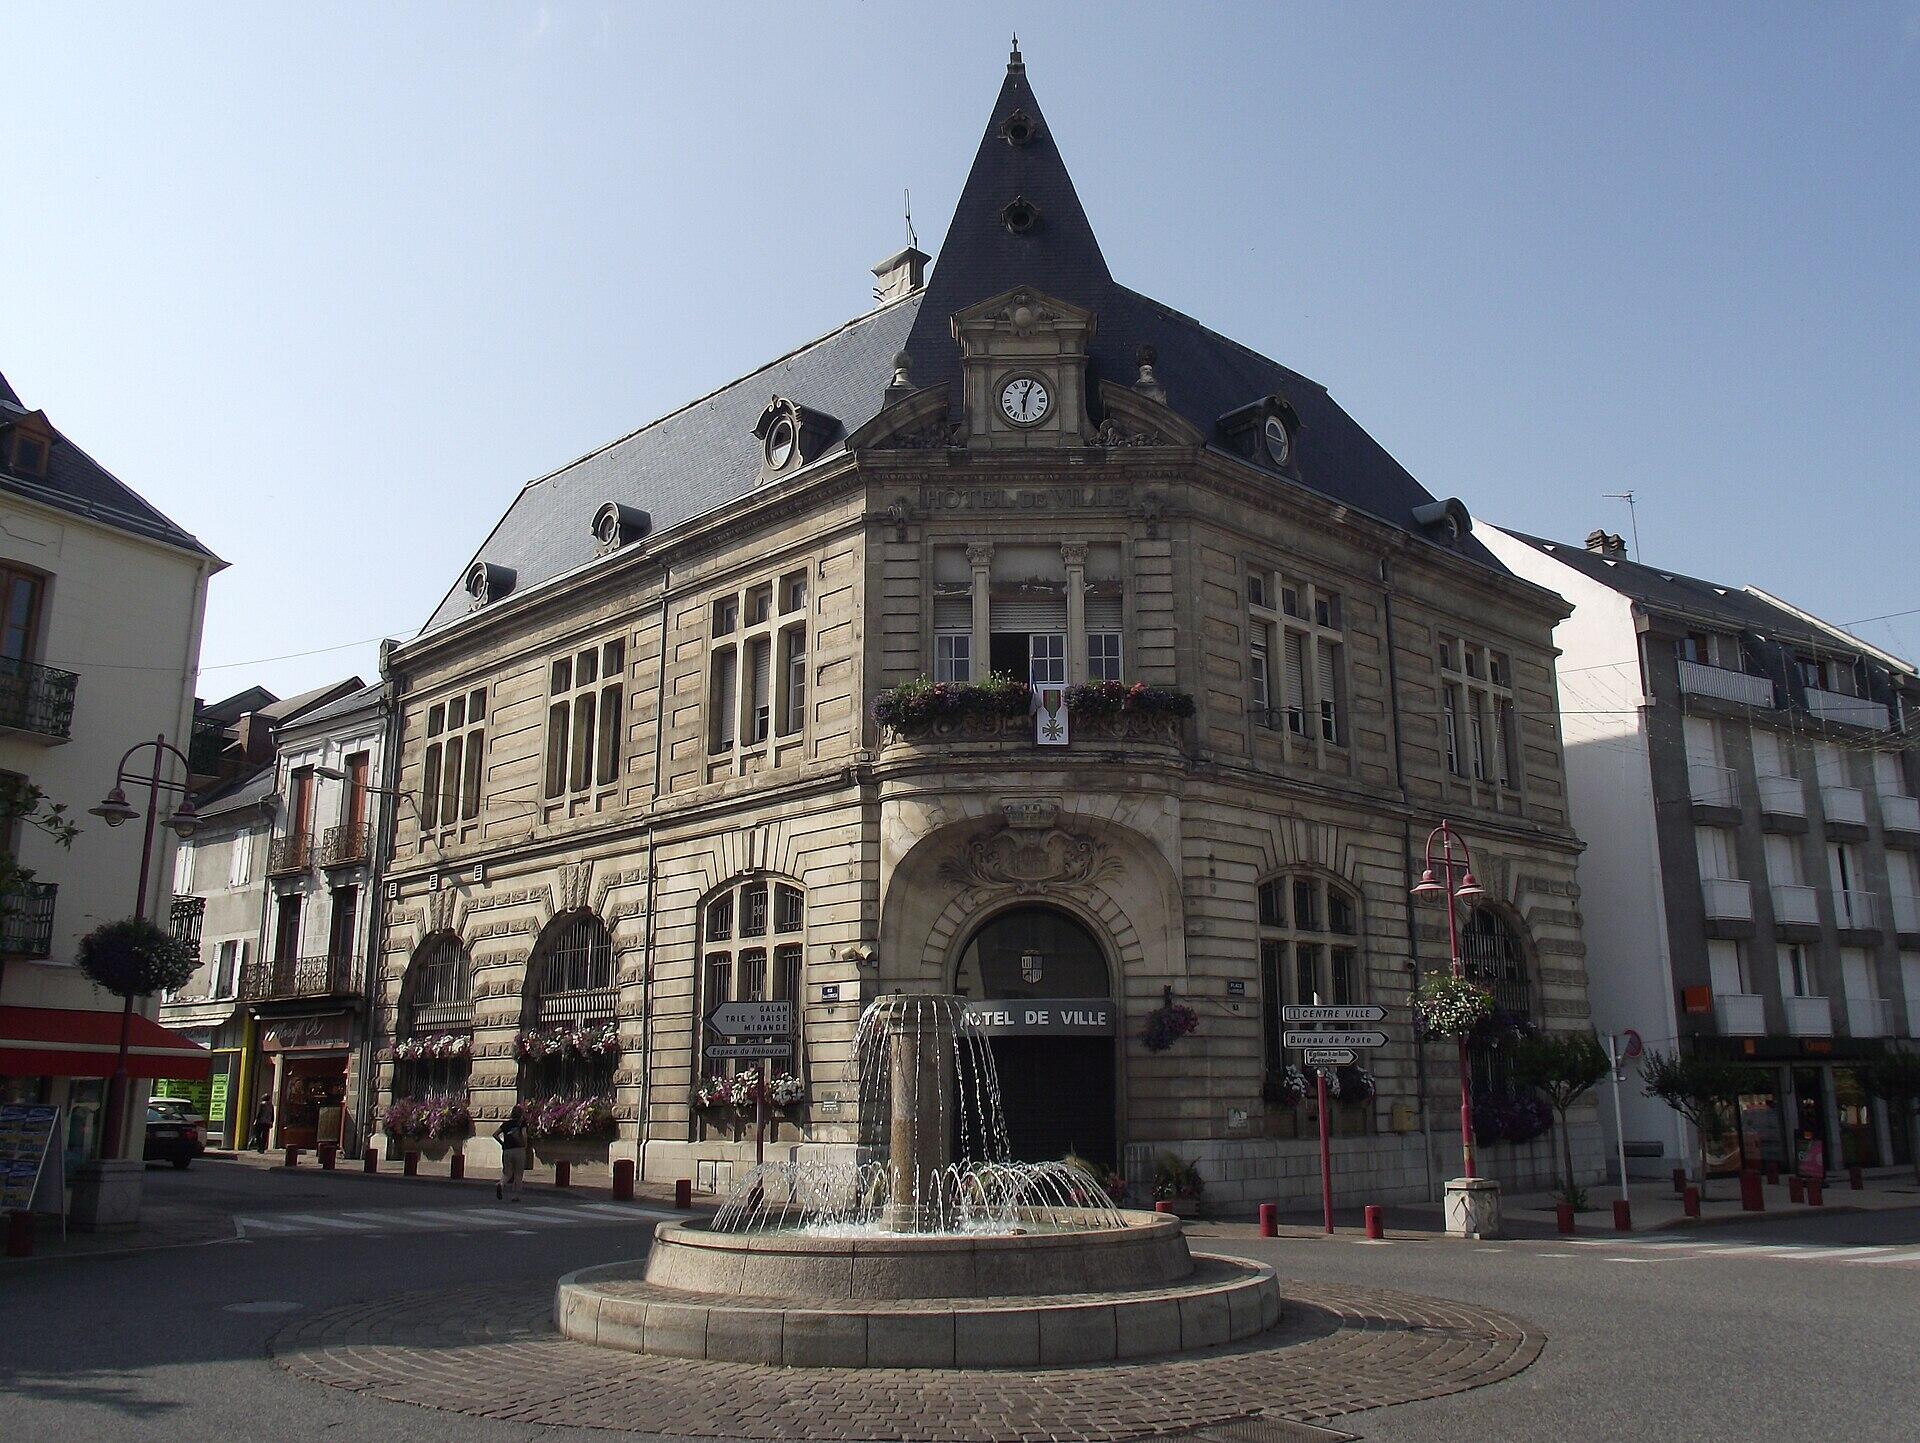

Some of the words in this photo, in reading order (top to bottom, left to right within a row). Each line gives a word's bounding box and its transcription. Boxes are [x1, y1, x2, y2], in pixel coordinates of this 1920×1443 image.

[1050, 488, 1130, 508] VILLE
[760, 1014, 787, 1022] BAISE
[1025, 1010, 1049, 1025] DE
[1061, 1010, 1106, 1025] VILLE
[1302, 1009, 1340, 1018] CENTRE
[1345, 1009, 1370, 1018] VILLE
[1290, 1035, 1324, 1044] Bureau
[1328, 1035, 1339, 1043] de
[1344, 1035, 1372, 1044] Poste
[712, 1047, 738, 1056] Espace
[740, 1047, 749, 1055] du
